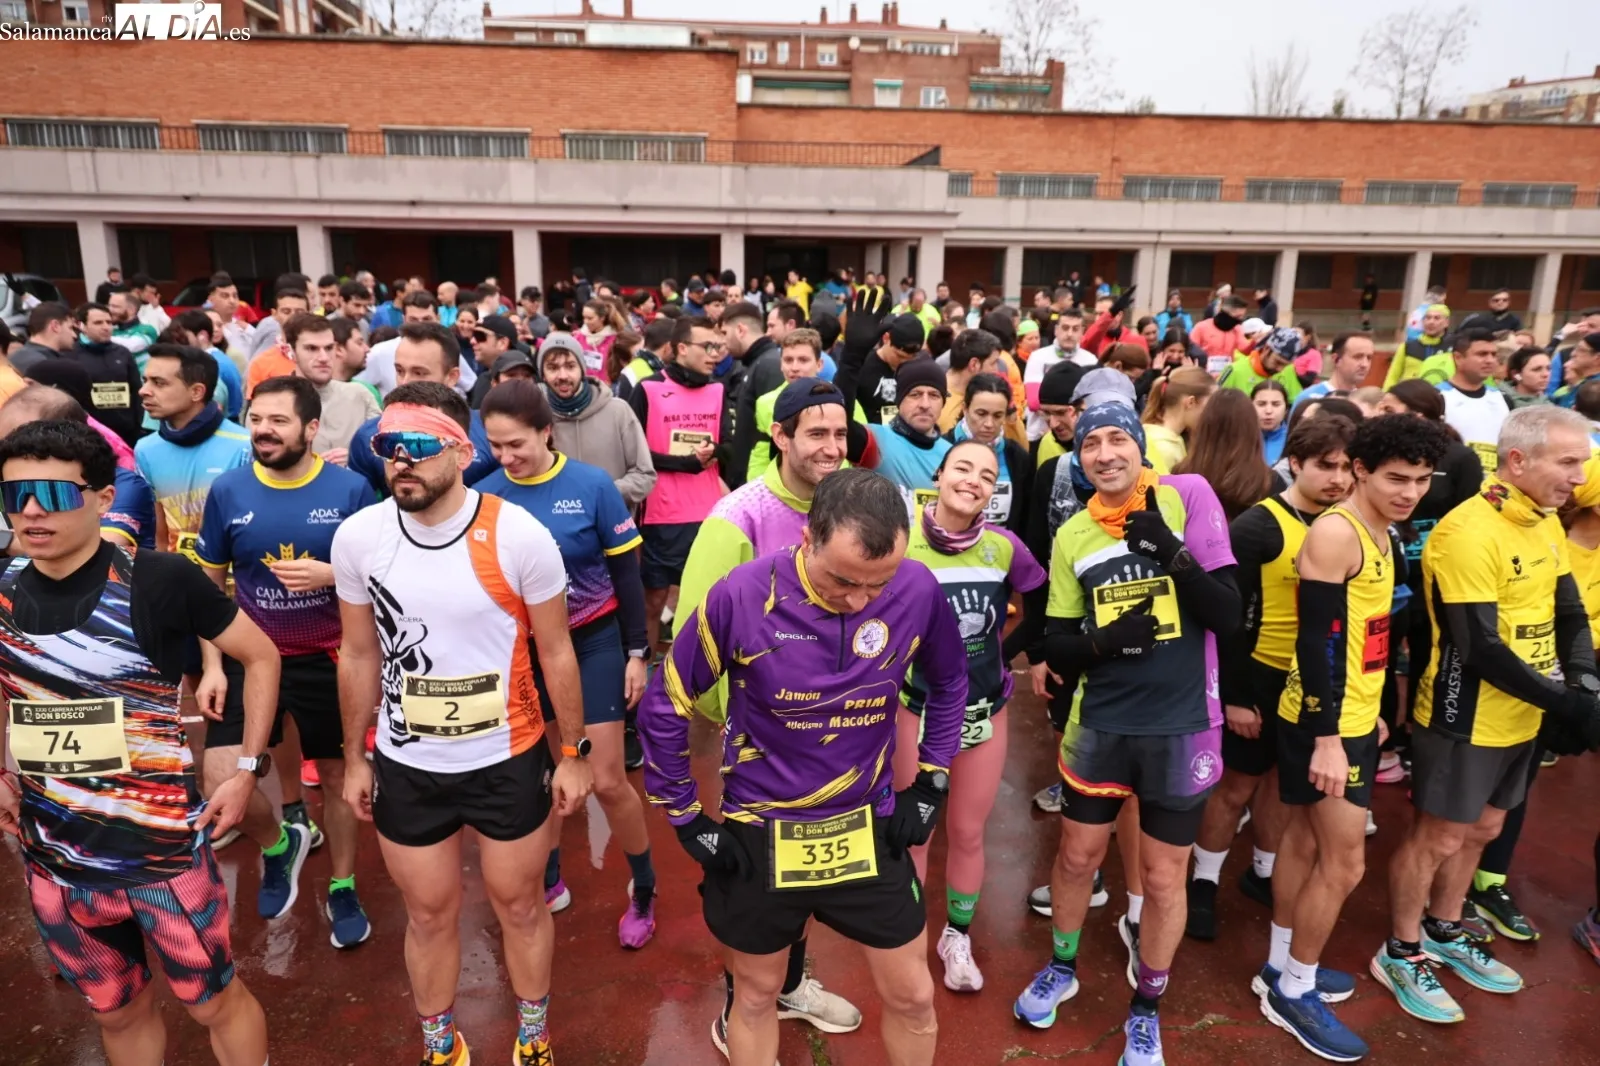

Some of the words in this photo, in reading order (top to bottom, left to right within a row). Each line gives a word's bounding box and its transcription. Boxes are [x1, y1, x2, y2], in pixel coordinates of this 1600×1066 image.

[554, 499, 582, 508] ADAS
[309, 508, 339, 517] ADAS
[256, 587, 284, 600] CAJA
[775, 631, 818, 640] MAGLIA
[1530, 639, 1555, 658] 21
[775, 688, 821, 701] Jamón
[844, 696, 887, 710] PRIM
[444, 701, 460, 721] 2
[785, 721, 823, 730] Atletismo
[829, 713, 886, 729] Macotera
[43, 730, 81, 755] 74
[824, 823, 846, 832] BOSCO
[697, 835, 717, 855] adidas
[802, 838, 850, 865] 335
